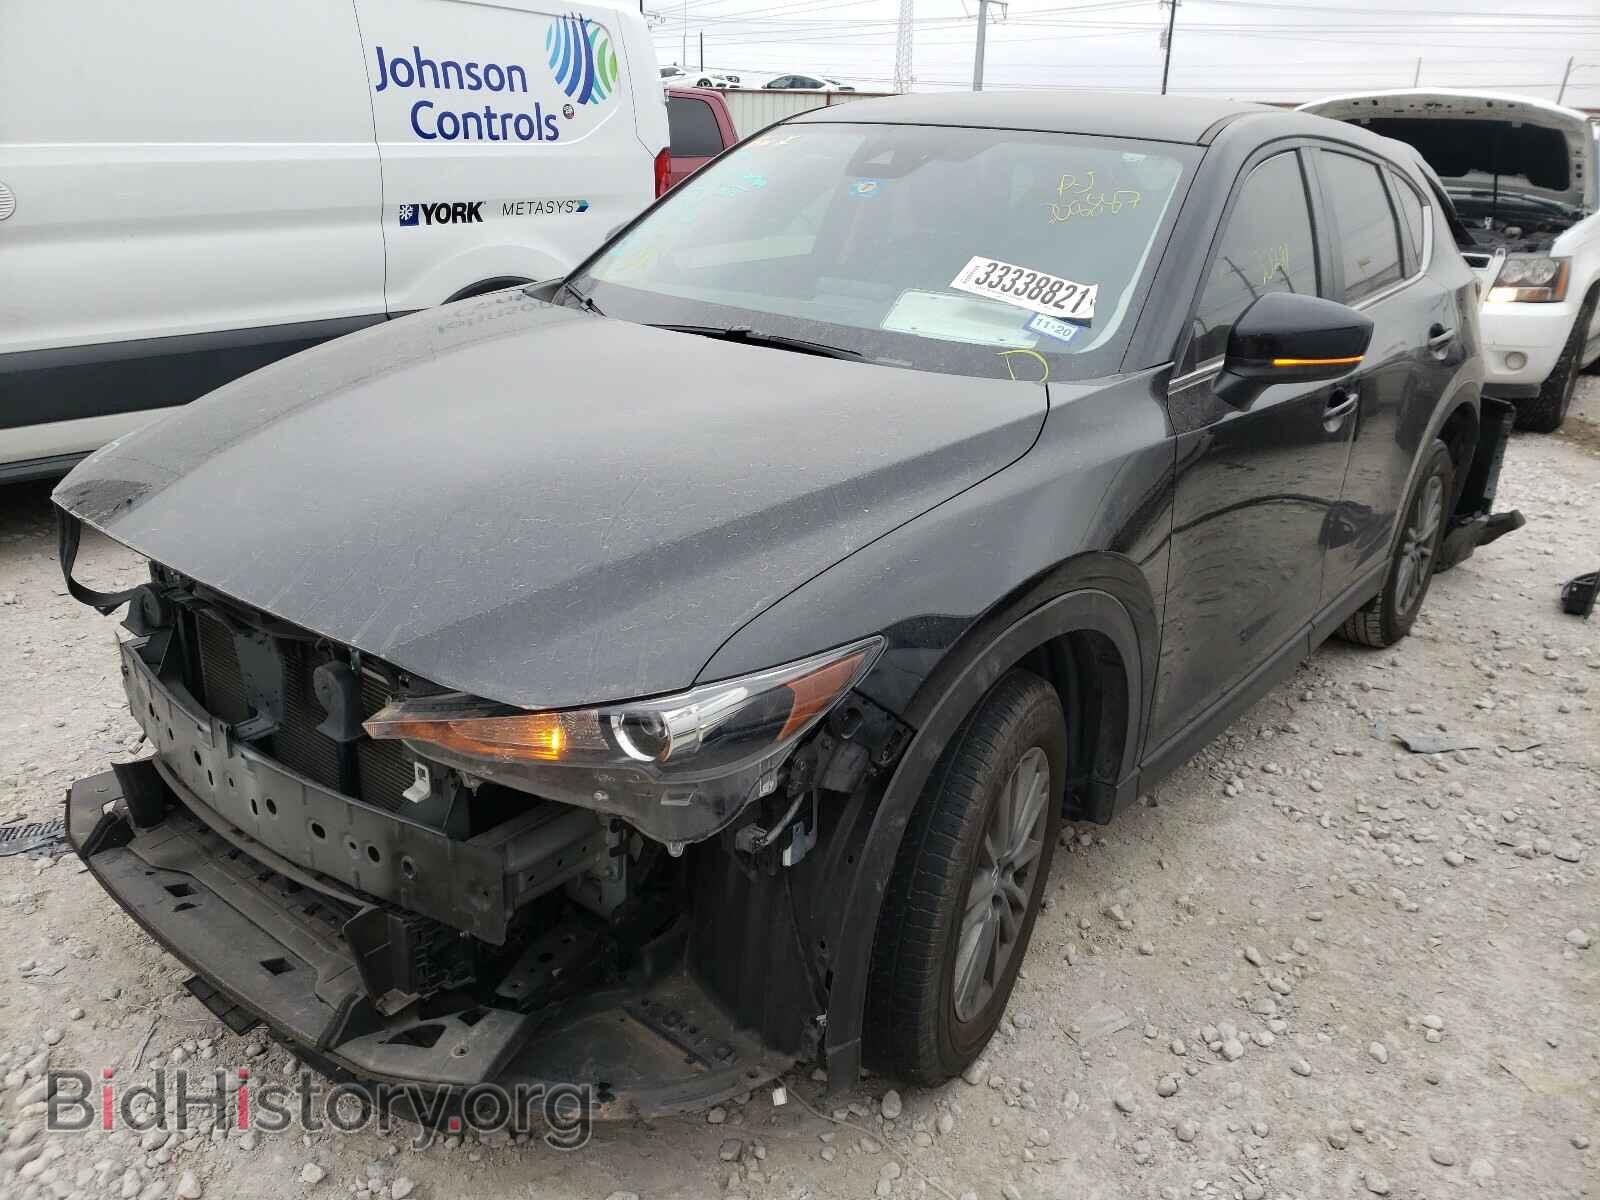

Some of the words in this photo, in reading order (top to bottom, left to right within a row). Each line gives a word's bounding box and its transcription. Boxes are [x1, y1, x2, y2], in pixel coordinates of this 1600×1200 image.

[376, 46, 528, 92] Johnson
[410, 100, 560, 141] Controls
[420, 201, 484, 226] YORK
[502, 200, 574, 217] METASYS
[974, 262, 1090, 313] 33338821
